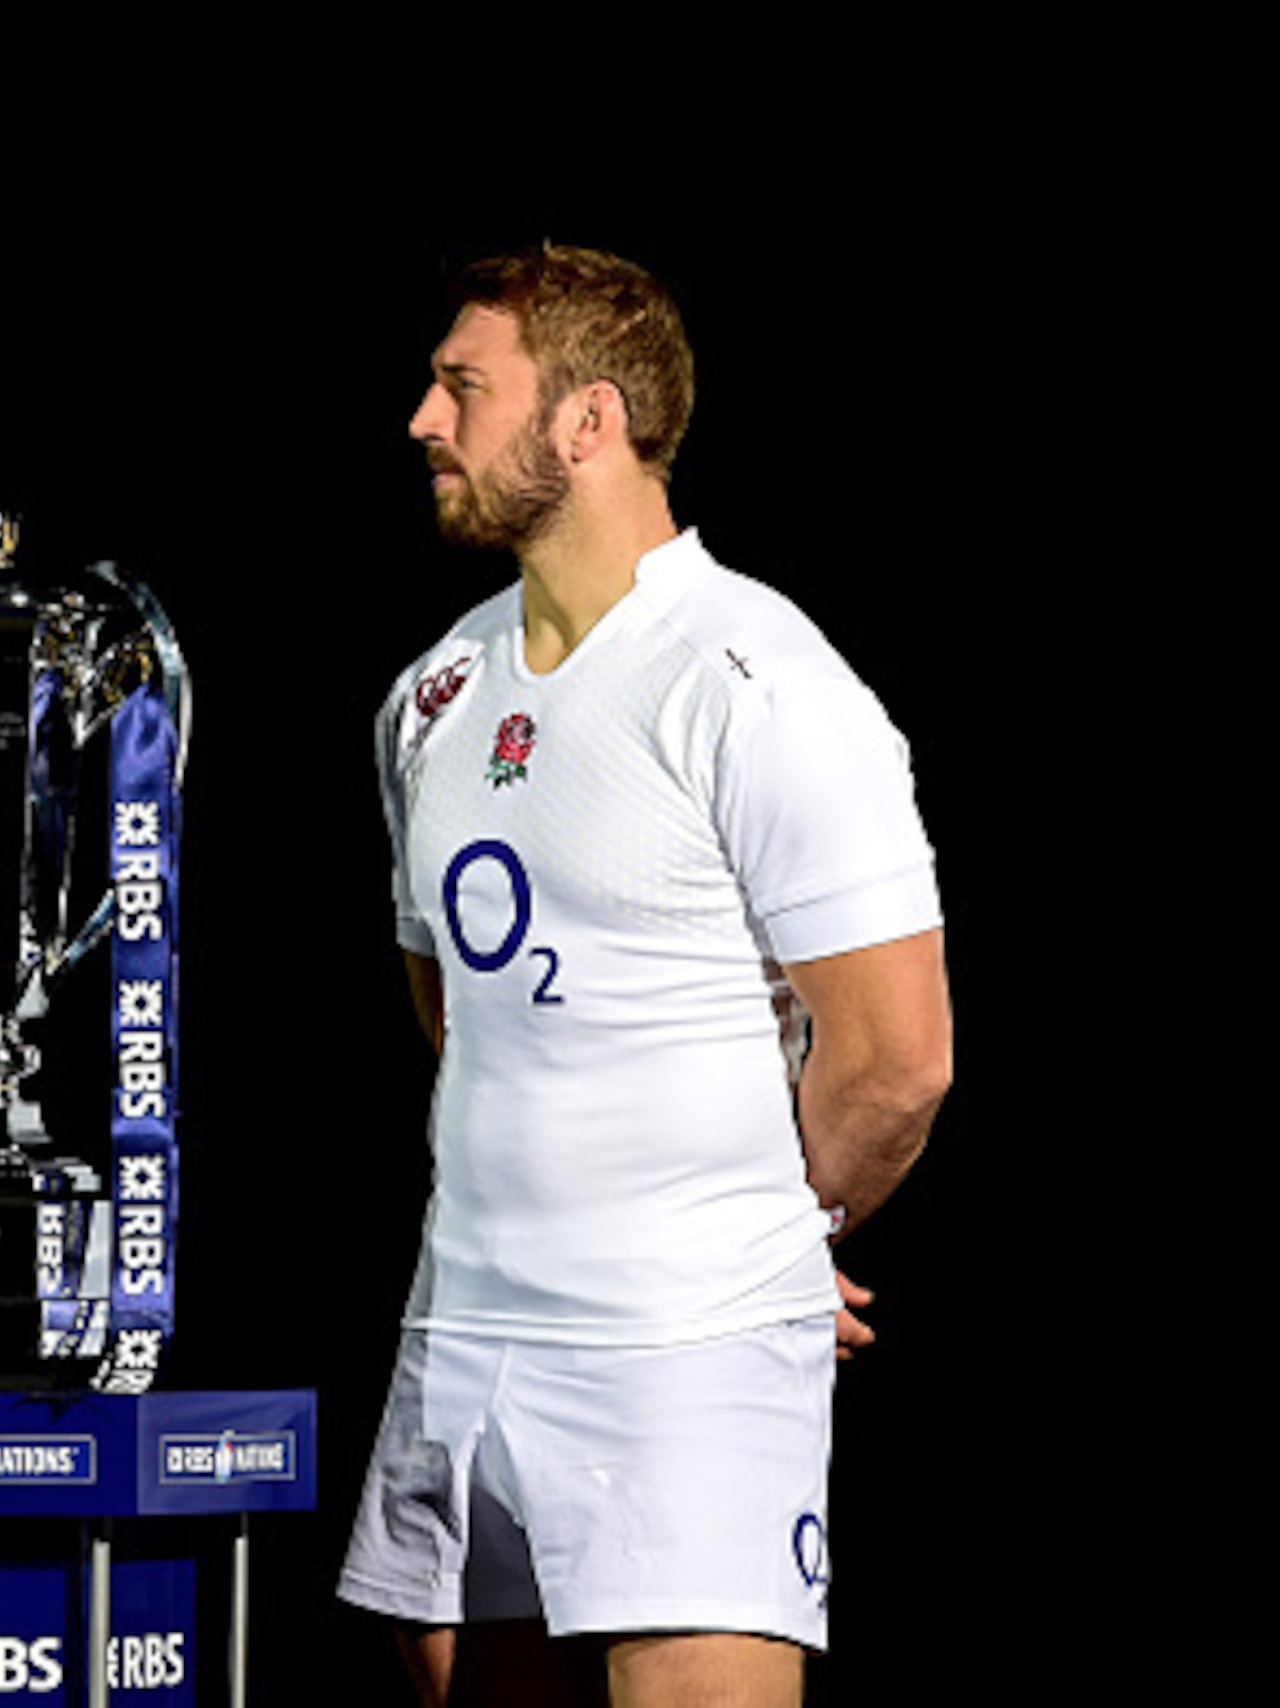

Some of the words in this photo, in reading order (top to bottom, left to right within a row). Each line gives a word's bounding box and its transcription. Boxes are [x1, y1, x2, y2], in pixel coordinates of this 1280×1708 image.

[117, 854, 162, 941] RBS
[119, 1032, 166, 1118] RBS
[120, 1204, 164, 1295] RBS
[122, 1632, 184, 1689] RBS
